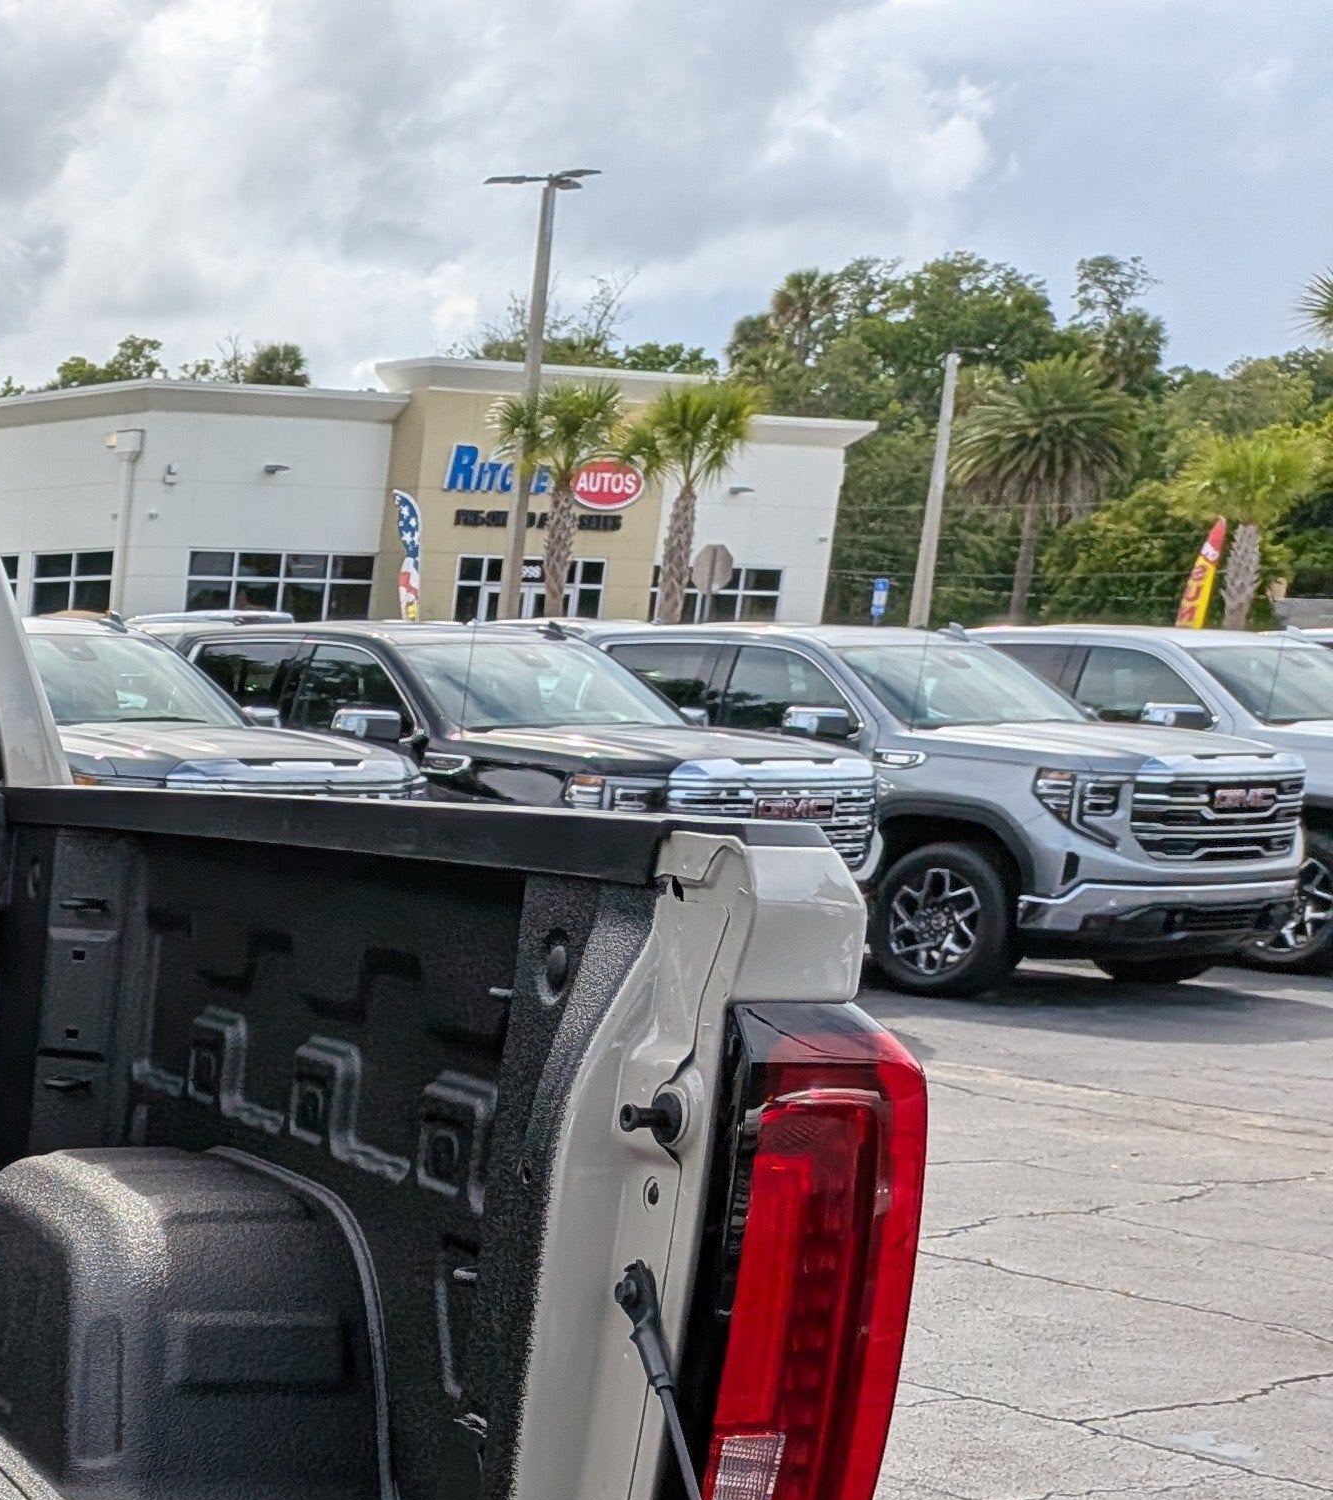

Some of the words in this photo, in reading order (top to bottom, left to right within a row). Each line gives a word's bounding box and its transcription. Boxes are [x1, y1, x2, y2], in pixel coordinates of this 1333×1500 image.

[575, 471, 638, 495] AUTOS
[1214, 788, 1277, 808] GMC
[757, 799, 833, 818] GMC
